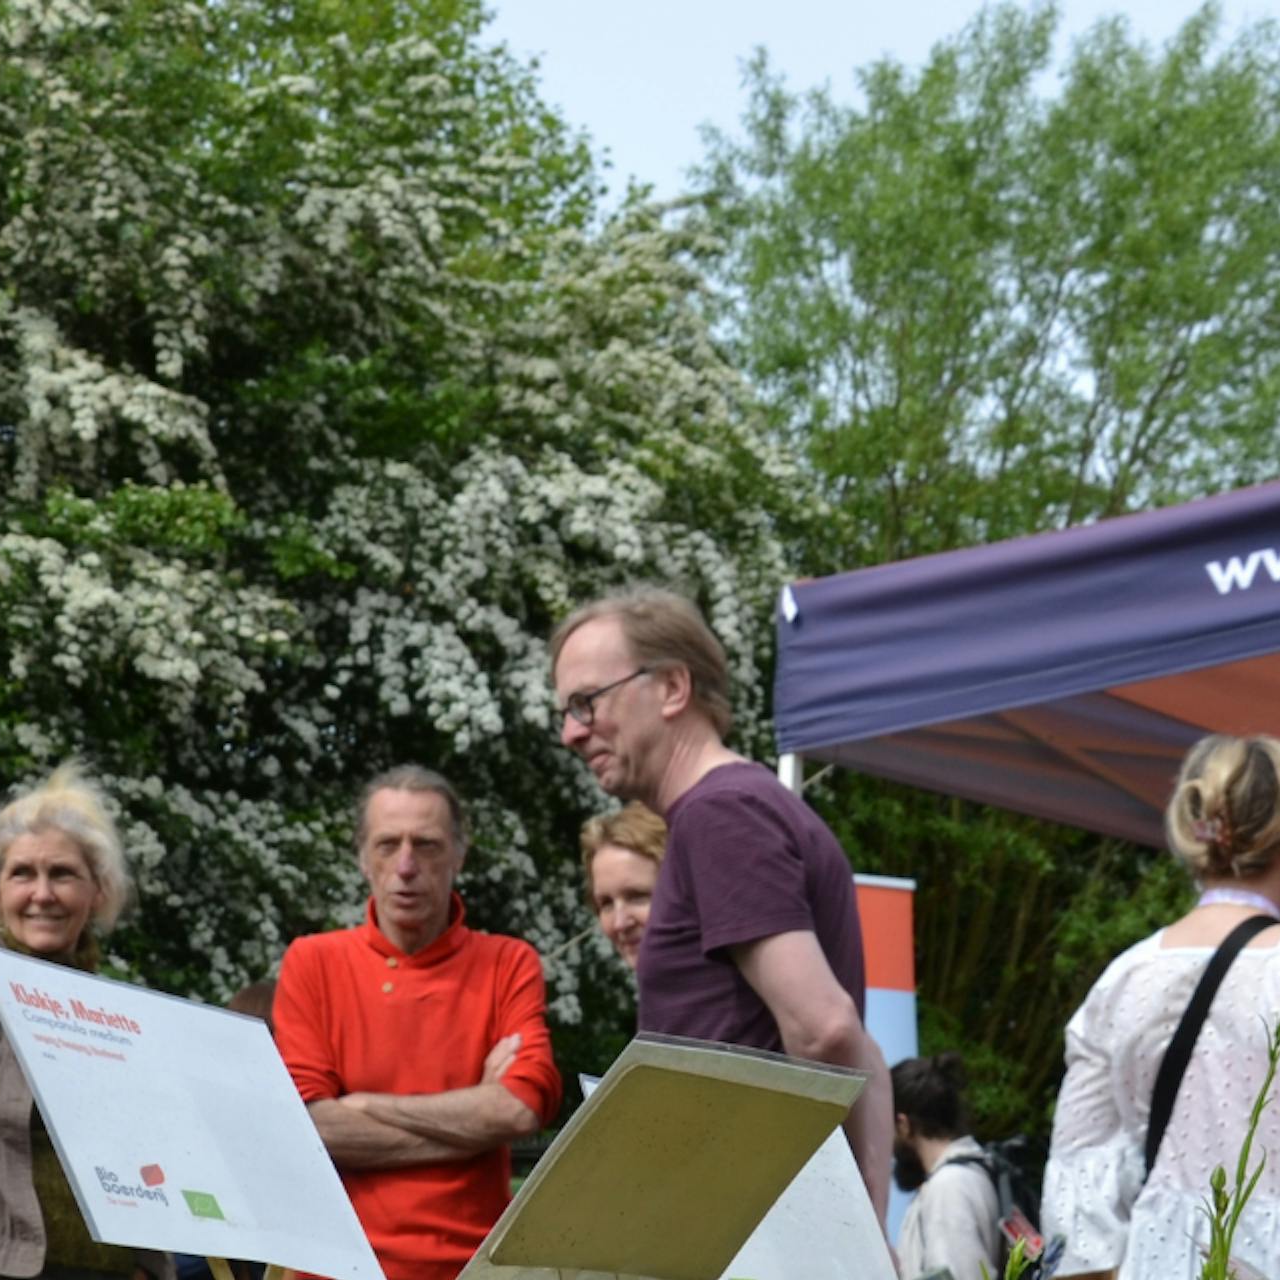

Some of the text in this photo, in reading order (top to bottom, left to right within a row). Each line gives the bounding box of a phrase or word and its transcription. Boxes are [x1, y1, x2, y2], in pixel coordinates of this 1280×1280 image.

[69, 998, 142, 1035] Mariette
[94, 1165, 119, 1182] Bio
[101, 1182, 169, 1208] boerderij
